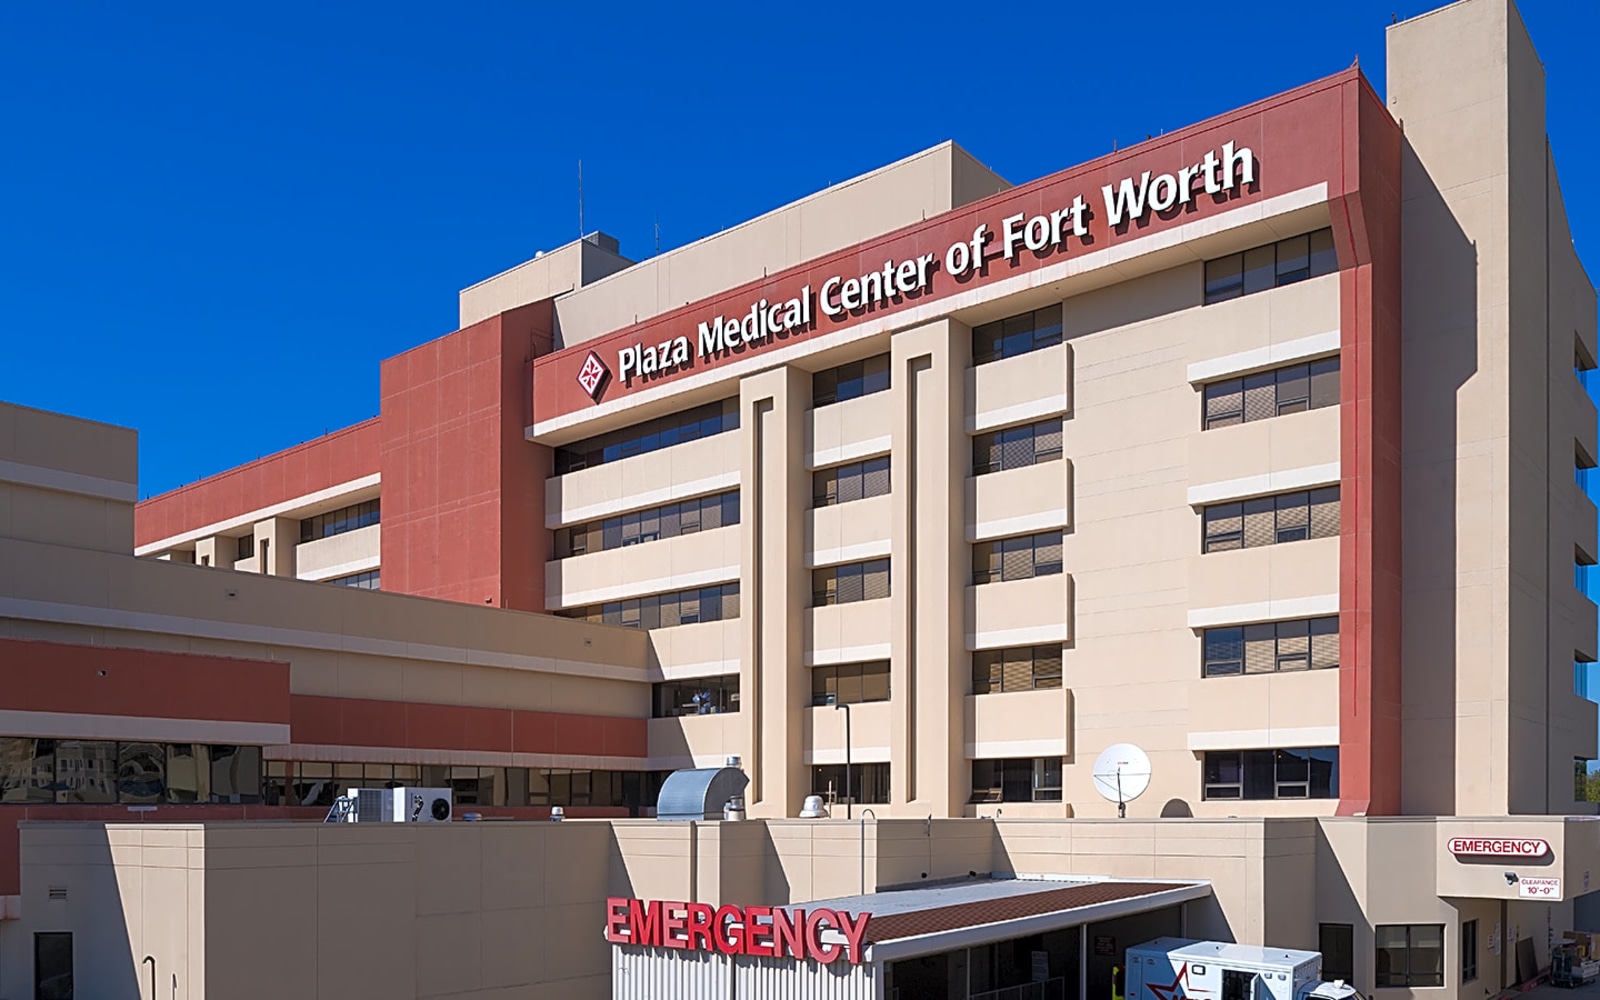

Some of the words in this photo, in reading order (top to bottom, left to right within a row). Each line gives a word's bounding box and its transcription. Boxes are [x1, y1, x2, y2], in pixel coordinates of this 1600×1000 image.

[618, 336, 690, 383] Plaza
[697, 284, 811, 358] Medical
[819, 251, 934, 316] Center
[945, 222, 987, 276] of
[1001, 194, 1088, 260] Fort
[1100, 139, 1255, 227] Worth
[1453, 841, 1540, 853] EMERGENCY
[607, 897, 872, 964] EMERGENCY
